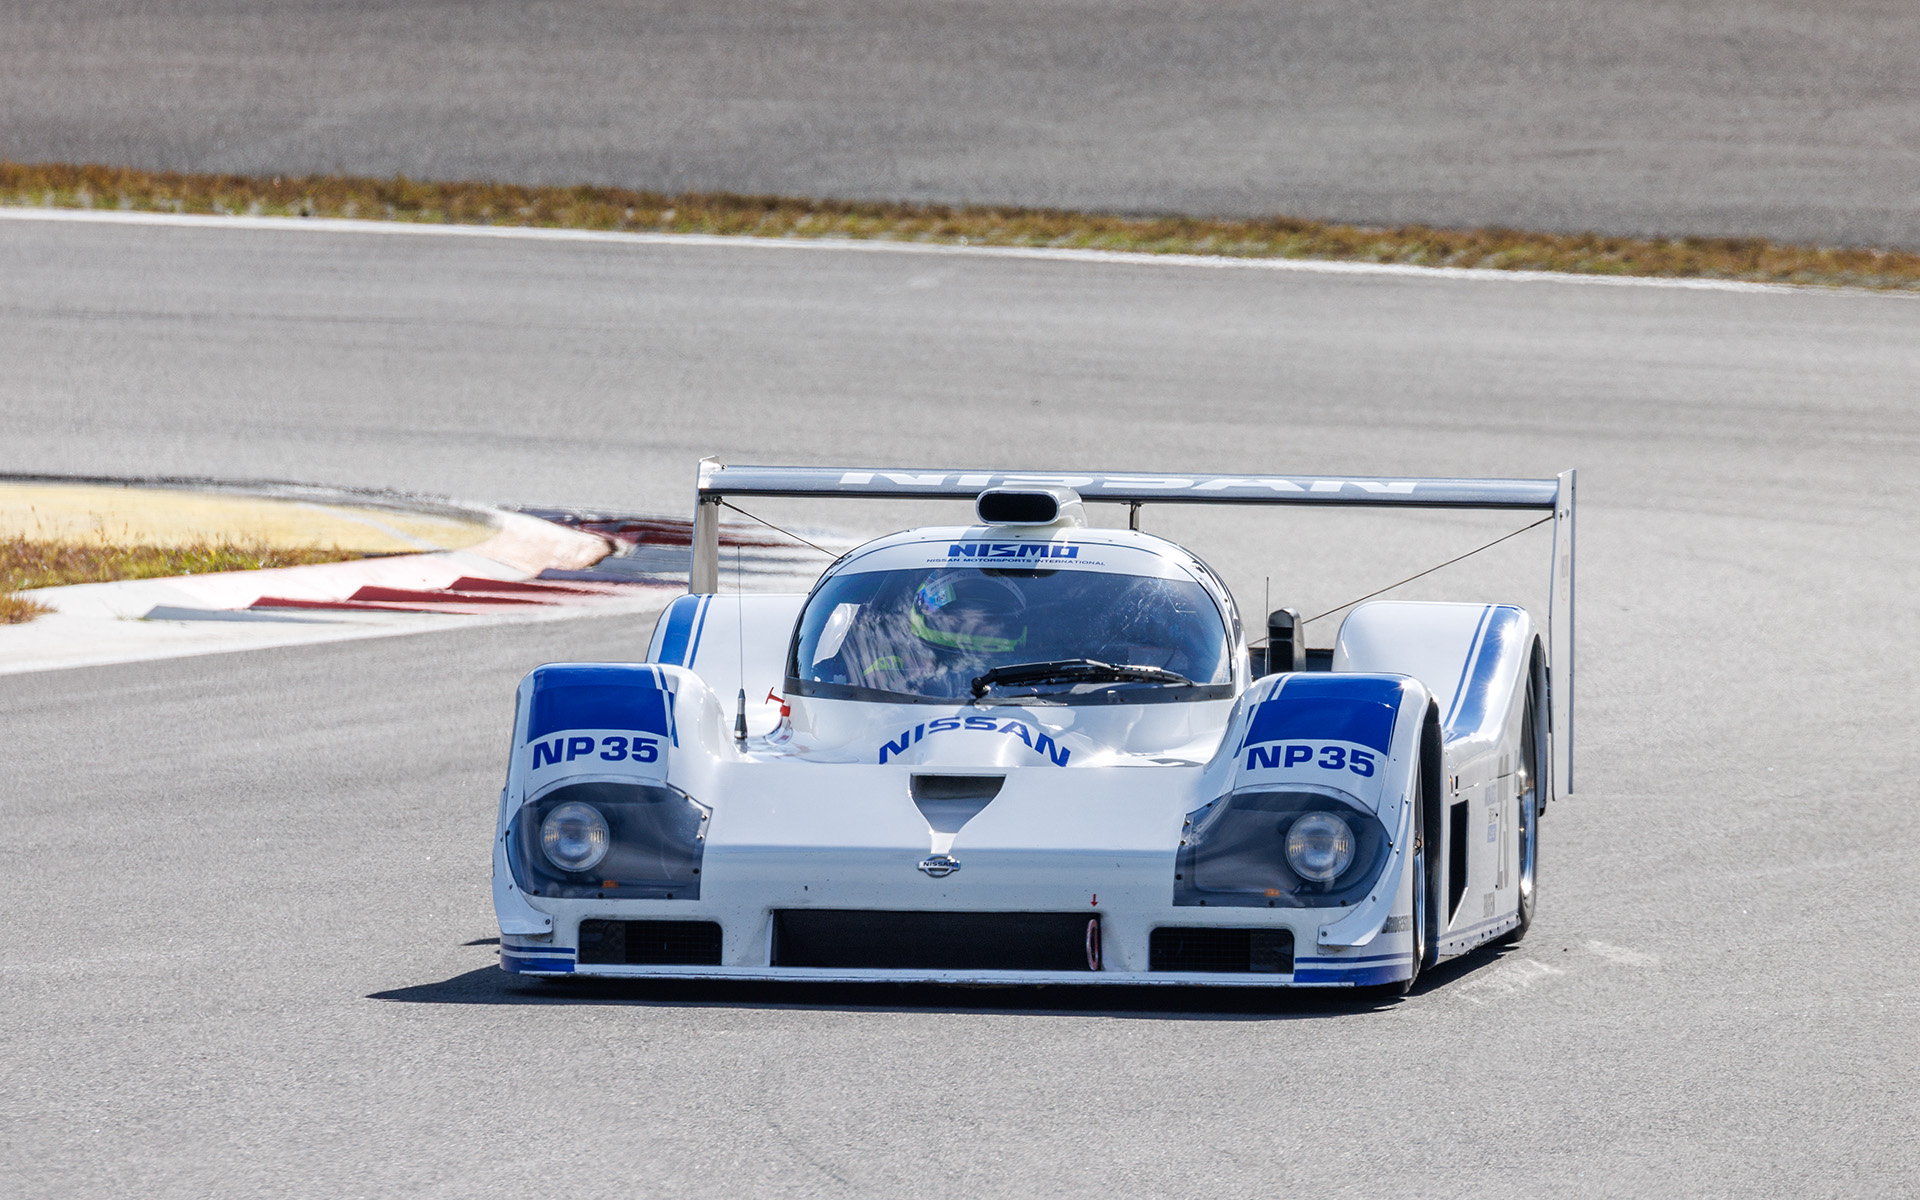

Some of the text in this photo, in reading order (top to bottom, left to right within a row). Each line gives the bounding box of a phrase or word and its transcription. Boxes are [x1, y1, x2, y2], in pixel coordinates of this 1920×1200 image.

[839, 472, 1418, 494] NISSAN
[947, 544, 1080, 559] NISMO
[1034, 558, 1106, 566] INTERNATIONAL
[532, 736, 659, 771] NP35
[879, 716, 1071, 767] NISSAN
[1246, 745, 1375, 778] NP35
